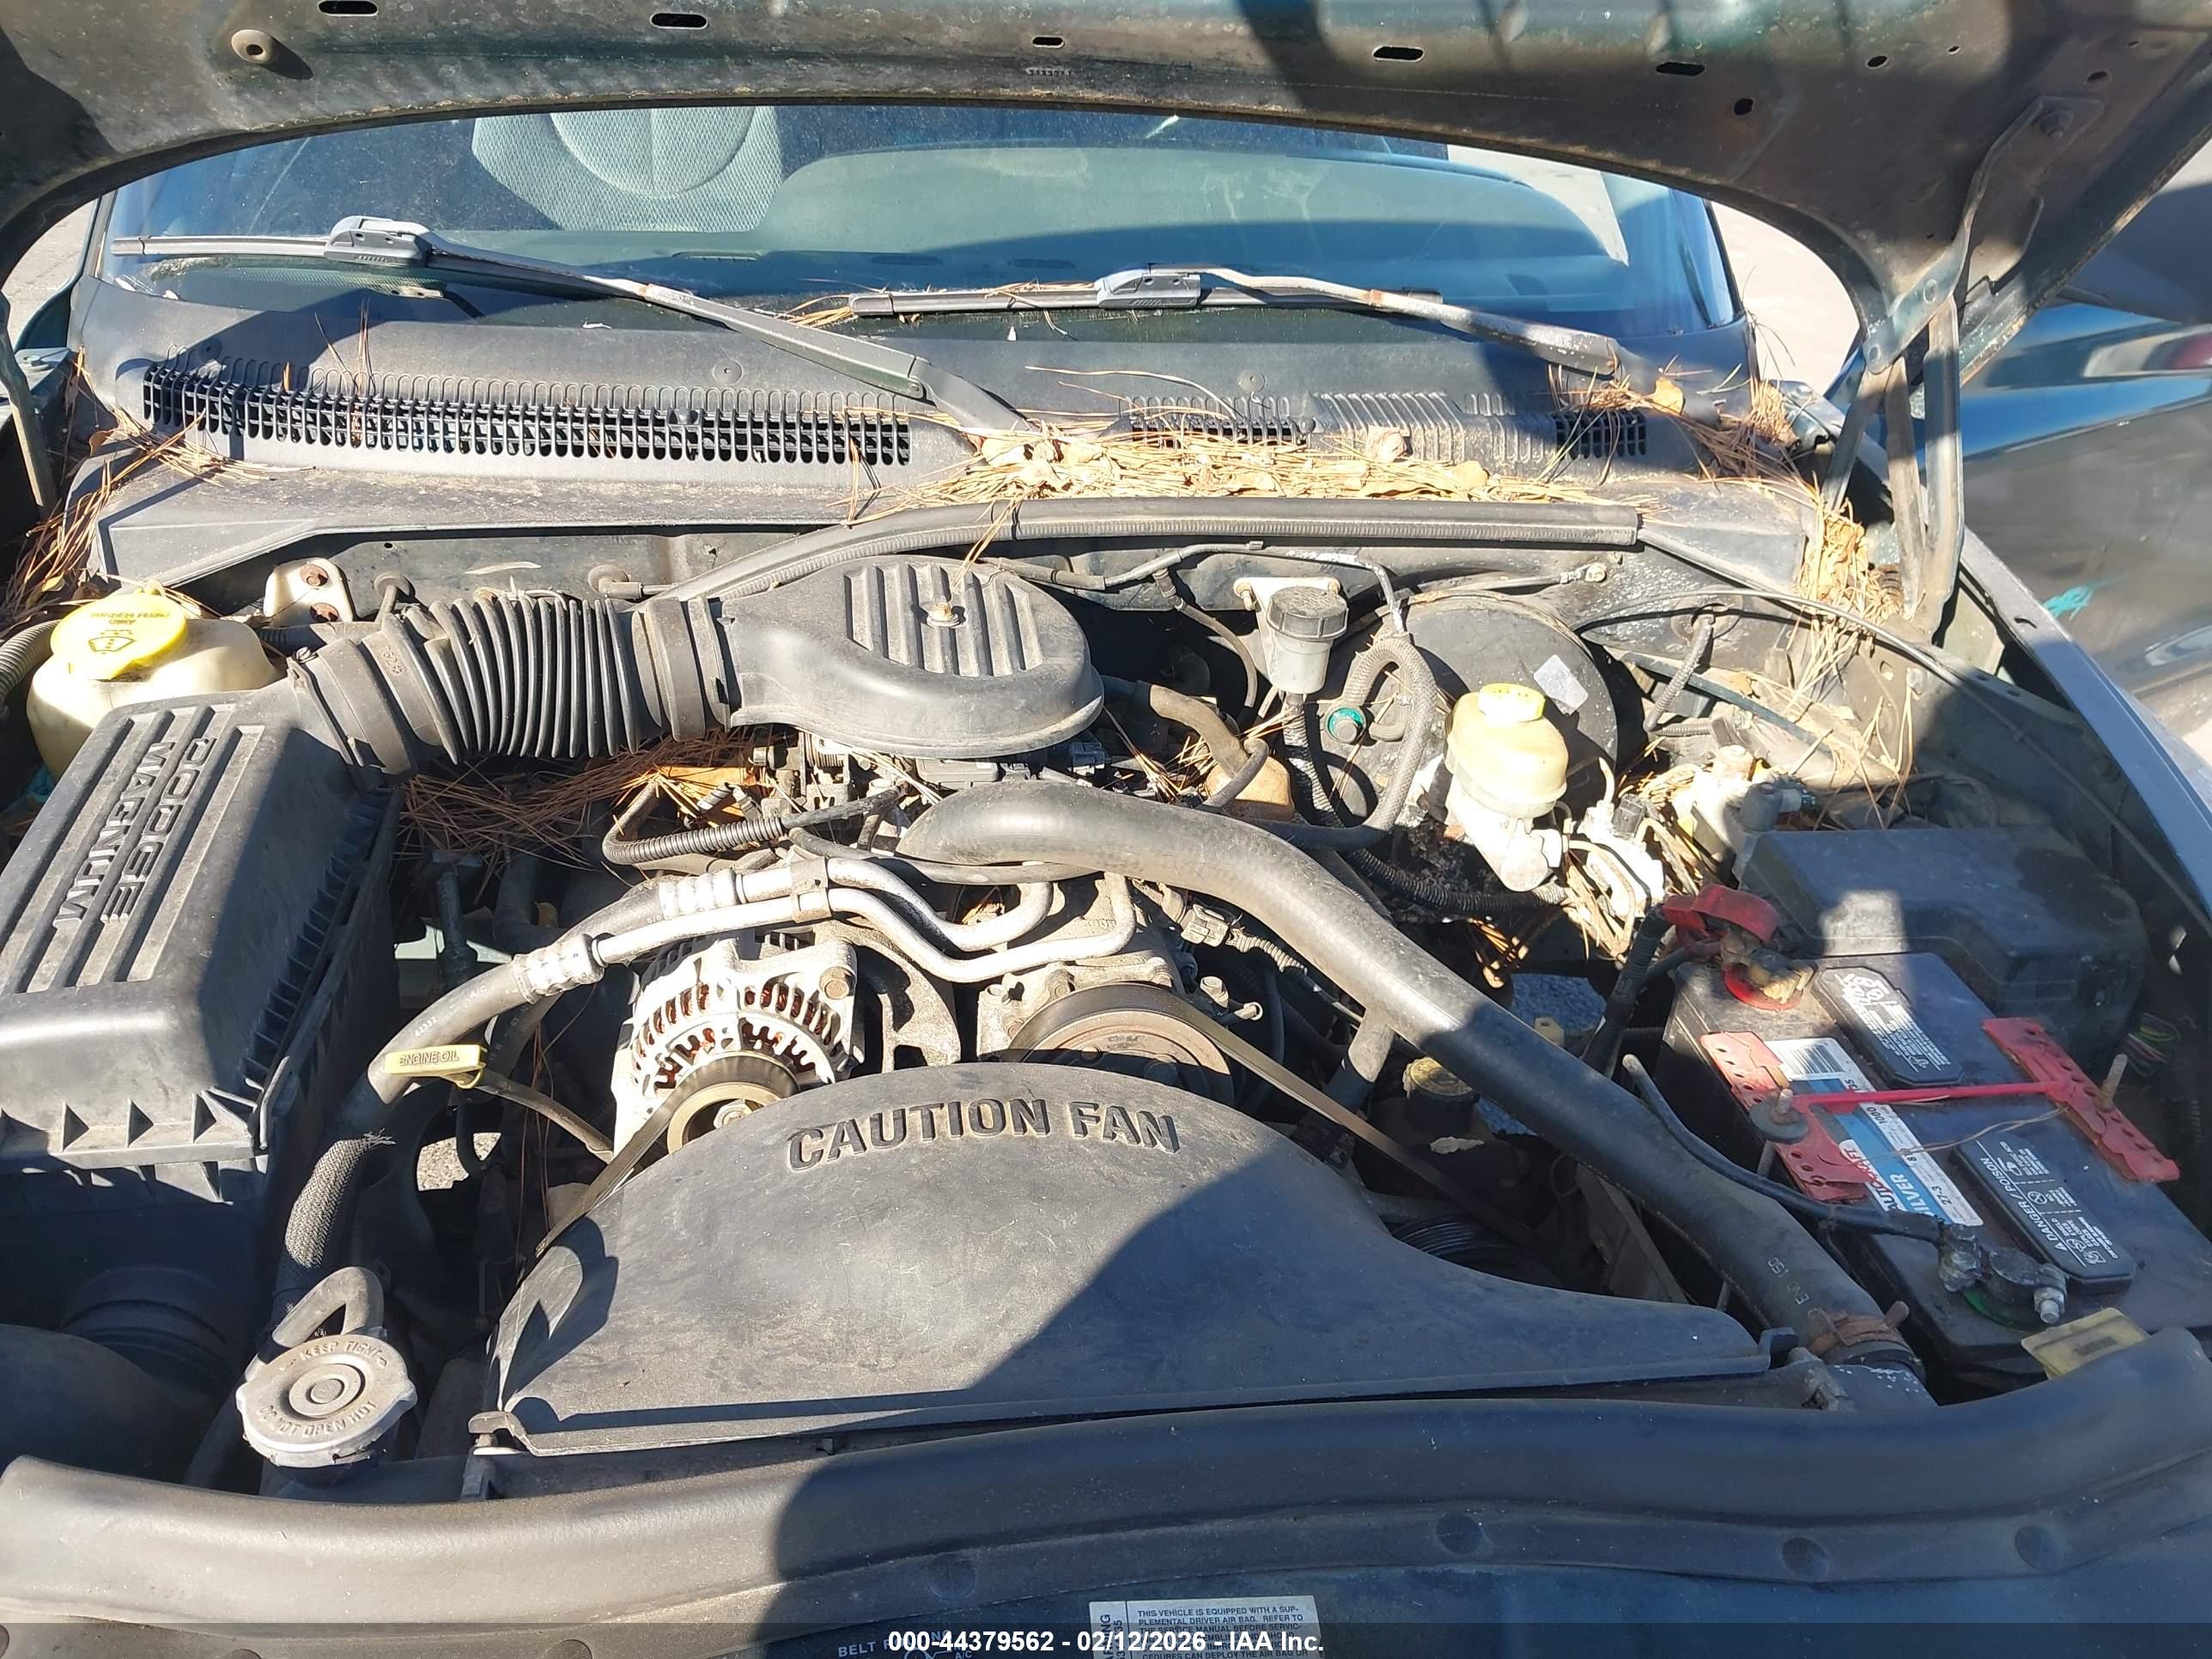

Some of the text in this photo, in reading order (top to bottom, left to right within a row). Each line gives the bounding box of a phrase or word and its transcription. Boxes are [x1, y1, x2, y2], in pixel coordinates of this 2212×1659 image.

[52, 742, 176, 929] MAGNUM
[100, 738, 217, 924] DODGE
[399, 1049, 459, 1066] ENGINE OIL
[1867, 1107, 1887, 1125] 1000
[787, 1097, 1182, 1172] CAUTION FAN
[1980, 1158, 2016, 1192] POISON
[2018, 1200, 2058, 1243] DANGER
[300, 1340, 382, 1361] KEEP TIGHT
[304, 1419, 346, 1437] OPEN
[1158, 1608, 1193, 1617] VEHICLE
[838, 1641, 876, 1658] BELT
